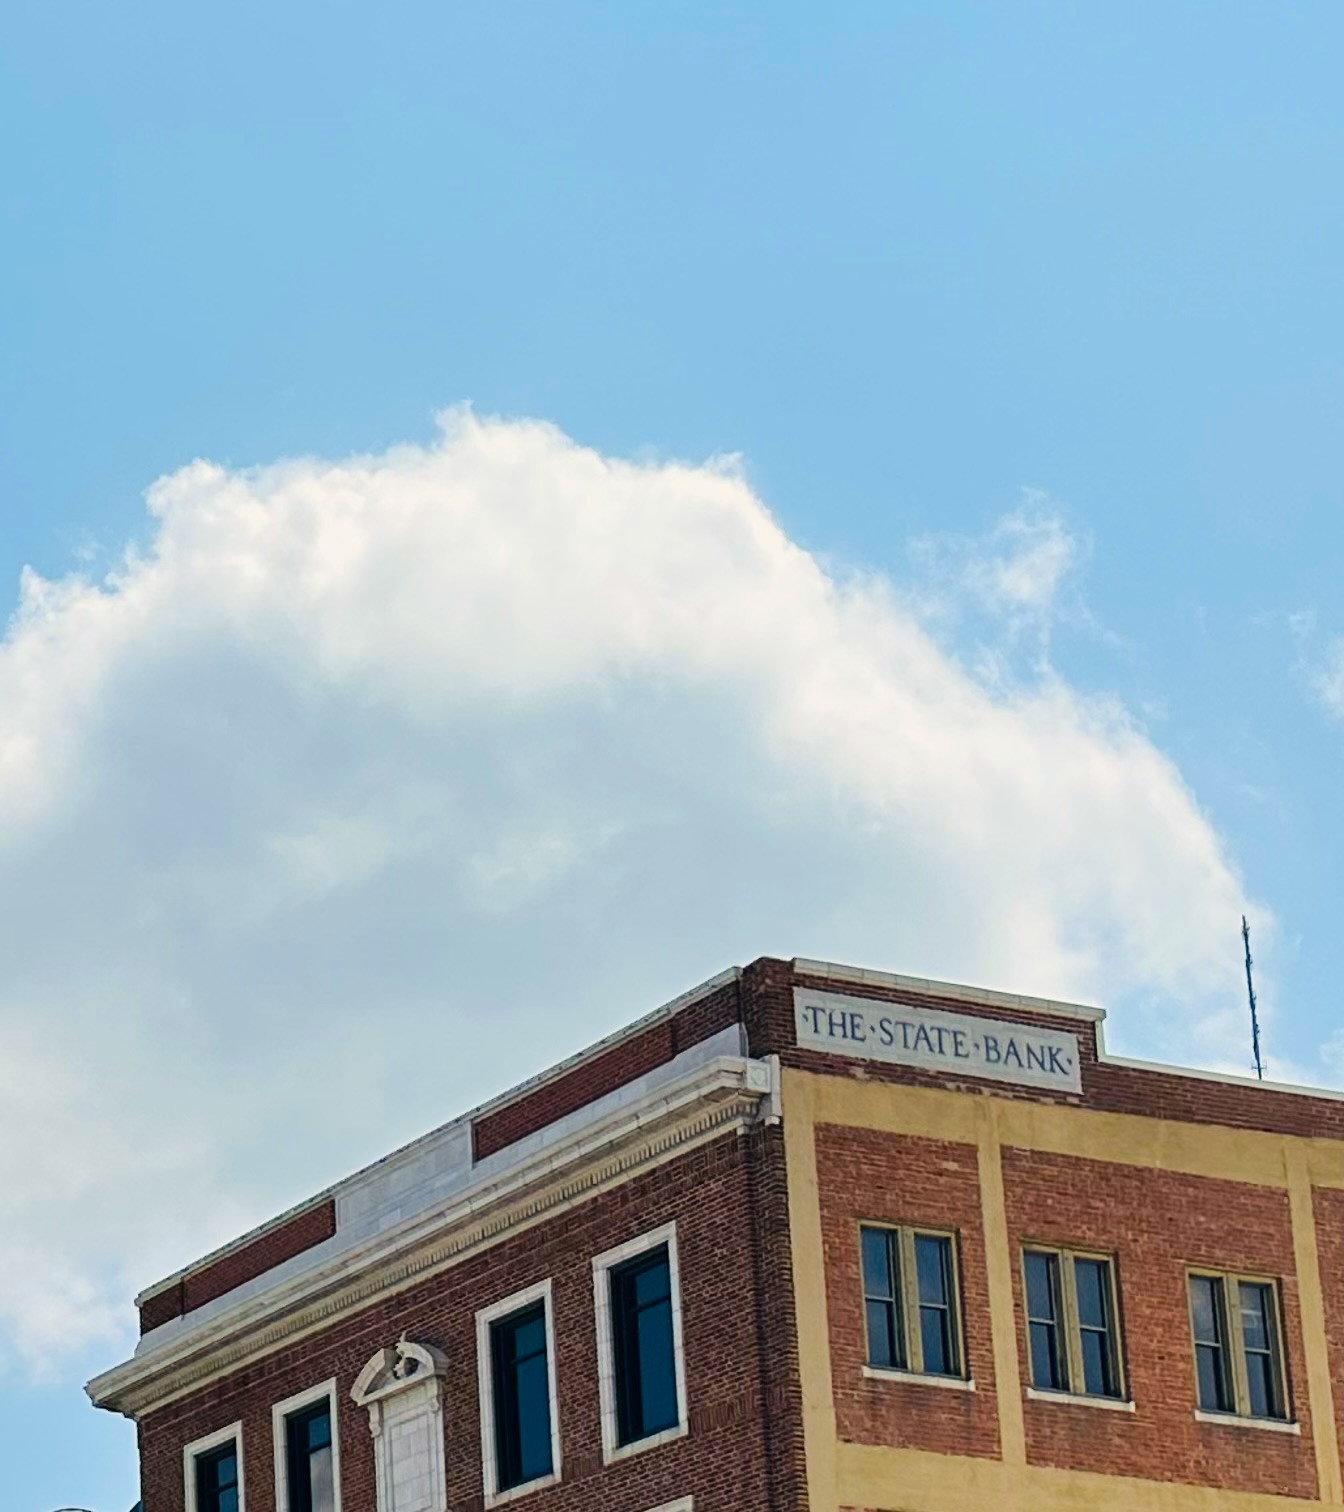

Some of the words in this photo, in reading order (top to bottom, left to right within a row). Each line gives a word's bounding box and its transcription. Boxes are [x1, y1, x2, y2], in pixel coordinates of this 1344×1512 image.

[805, 1005, 865, 1042] THE
[879, 1018, 969, 1058] STATE
[983, 1035, 1069, 1075] BANK
